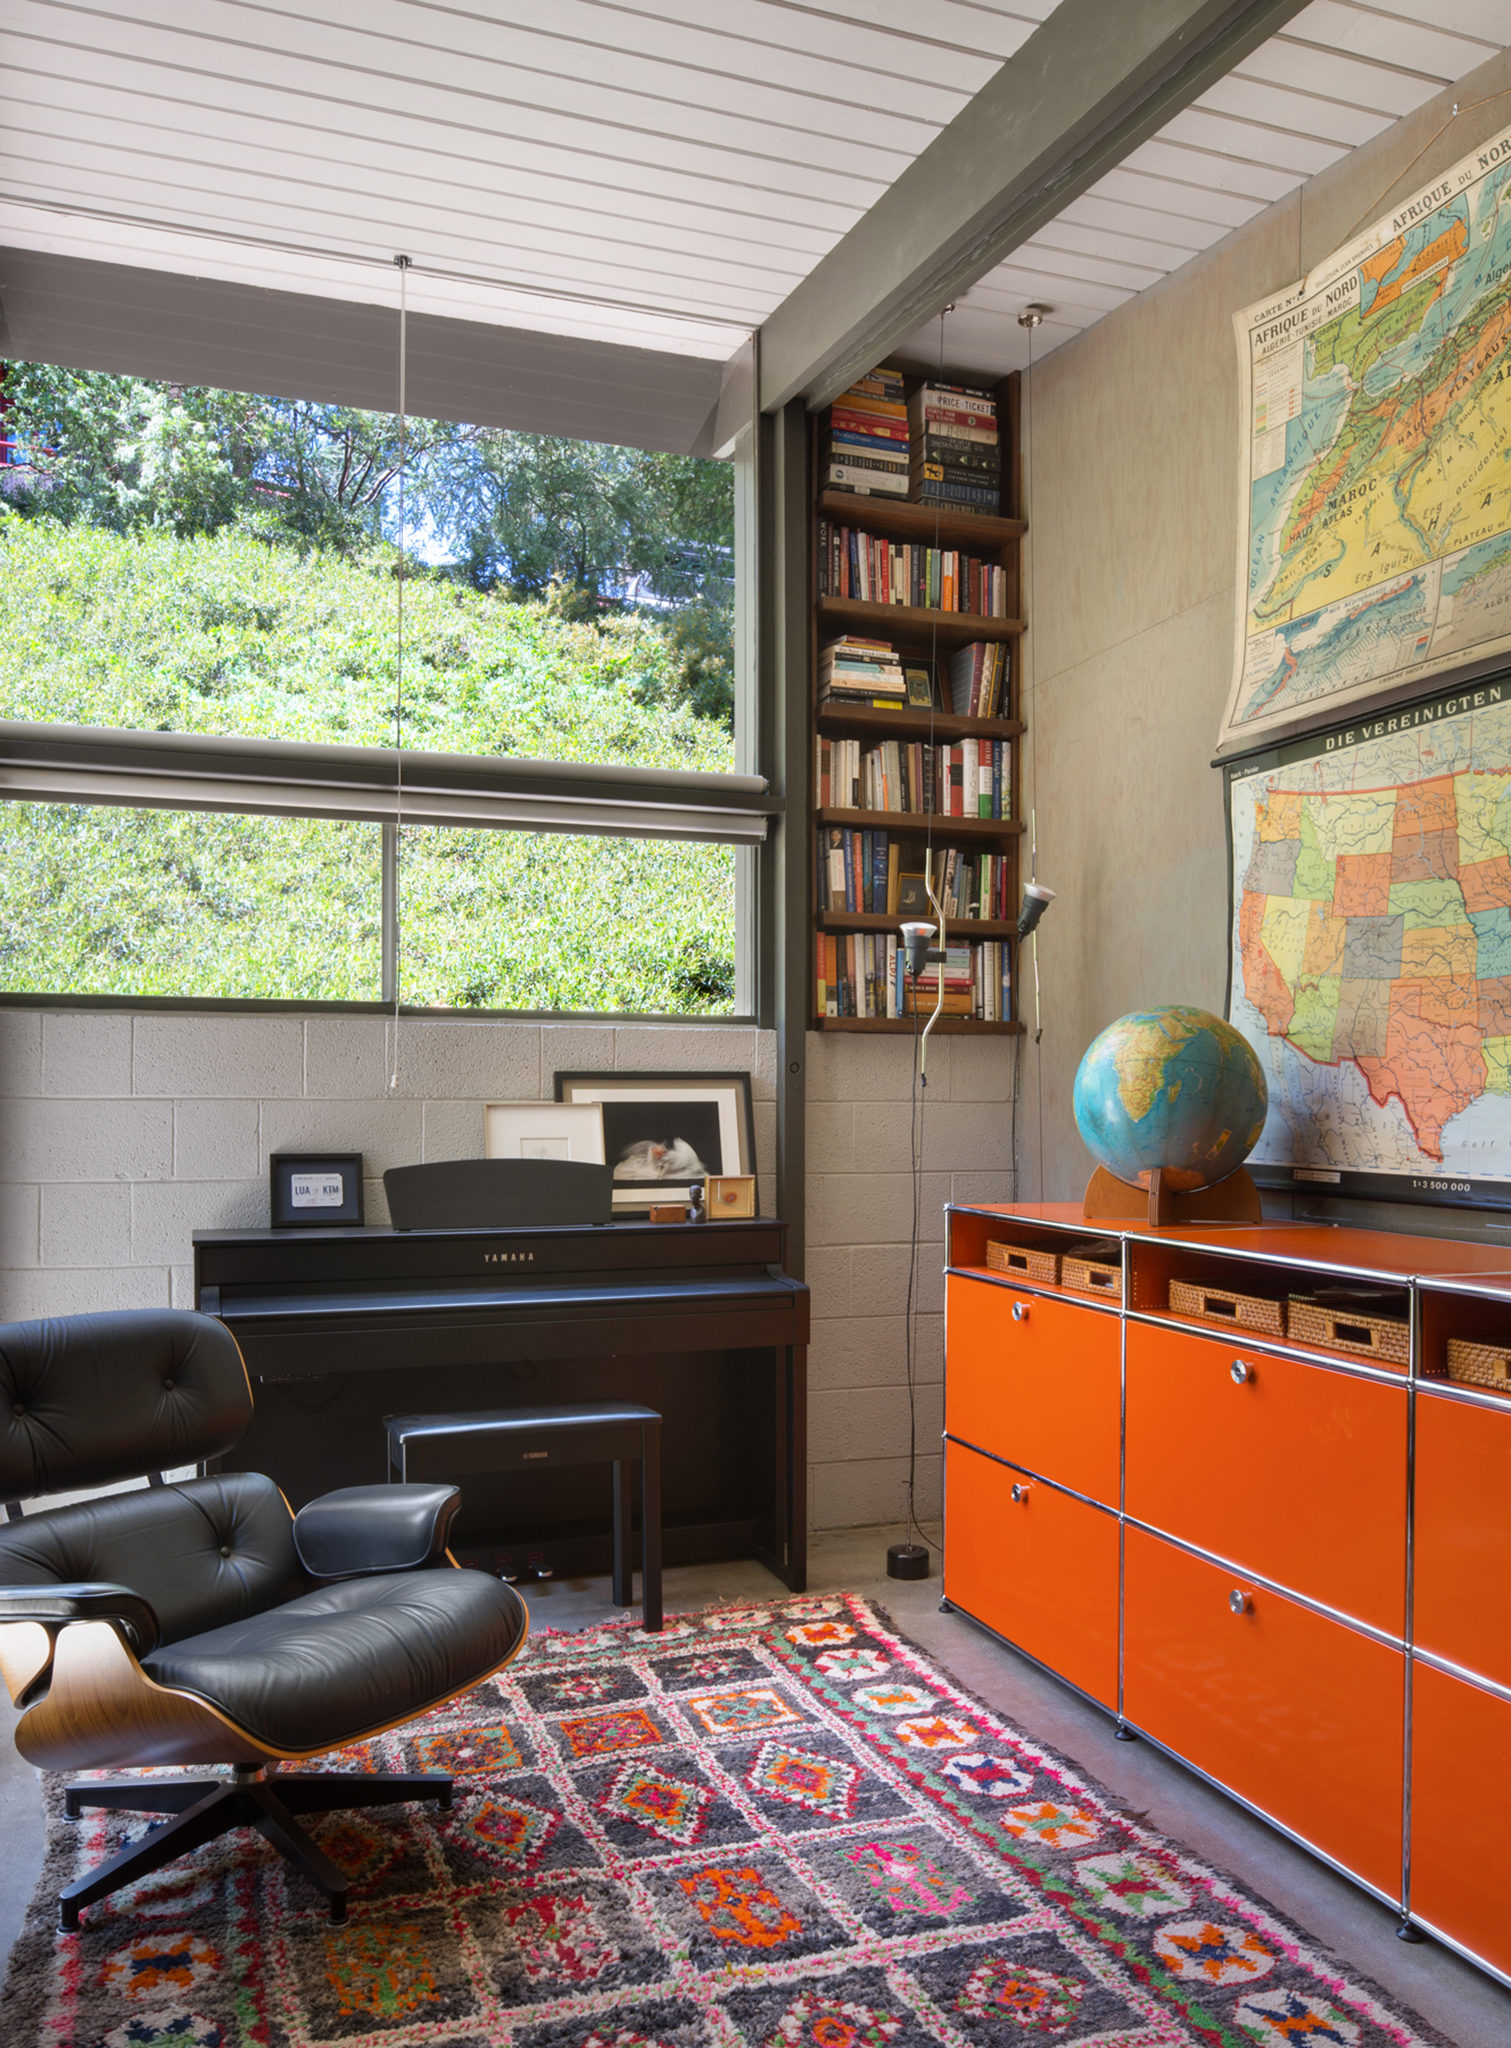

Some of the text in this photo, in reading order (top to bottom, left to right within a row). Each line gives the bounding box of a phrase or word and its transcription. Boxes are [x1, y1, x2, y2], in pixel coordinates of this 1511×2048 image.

[1392, 136, 1511, 232] AFRIQUE DU NOR
[1485, 261, 1511, 286] Alge
[1254, 276, 1358, 347] AFRIQUE DU NORD
[1254, 303, 1283, 323] CARTE
[1422, 347, 1440, 362] Oran
[860, 399, 894, 412] POSTWAR
[938, 395, 990, 414] PRICE TICKET
[846, 475, 886, 487] WASHINGTON
[1328, 478, 1377, 512] MAROC
[1289, 505, 1353, 545] HAUT ATLAS
[1453, 524, 1494, 547] PLATEAU
[1326, 686, 1501, 750] DIE VEREINIGTEN
[1461, 1140, 1495, 1148] Golf
[295, 1185, 340, 1195] LUA KTM
[1430, 1181, 1448, 1190] 500
[1451, 1183, 1471, 1192] 000
[484, 1252, 534, 1262] YAMAHA
